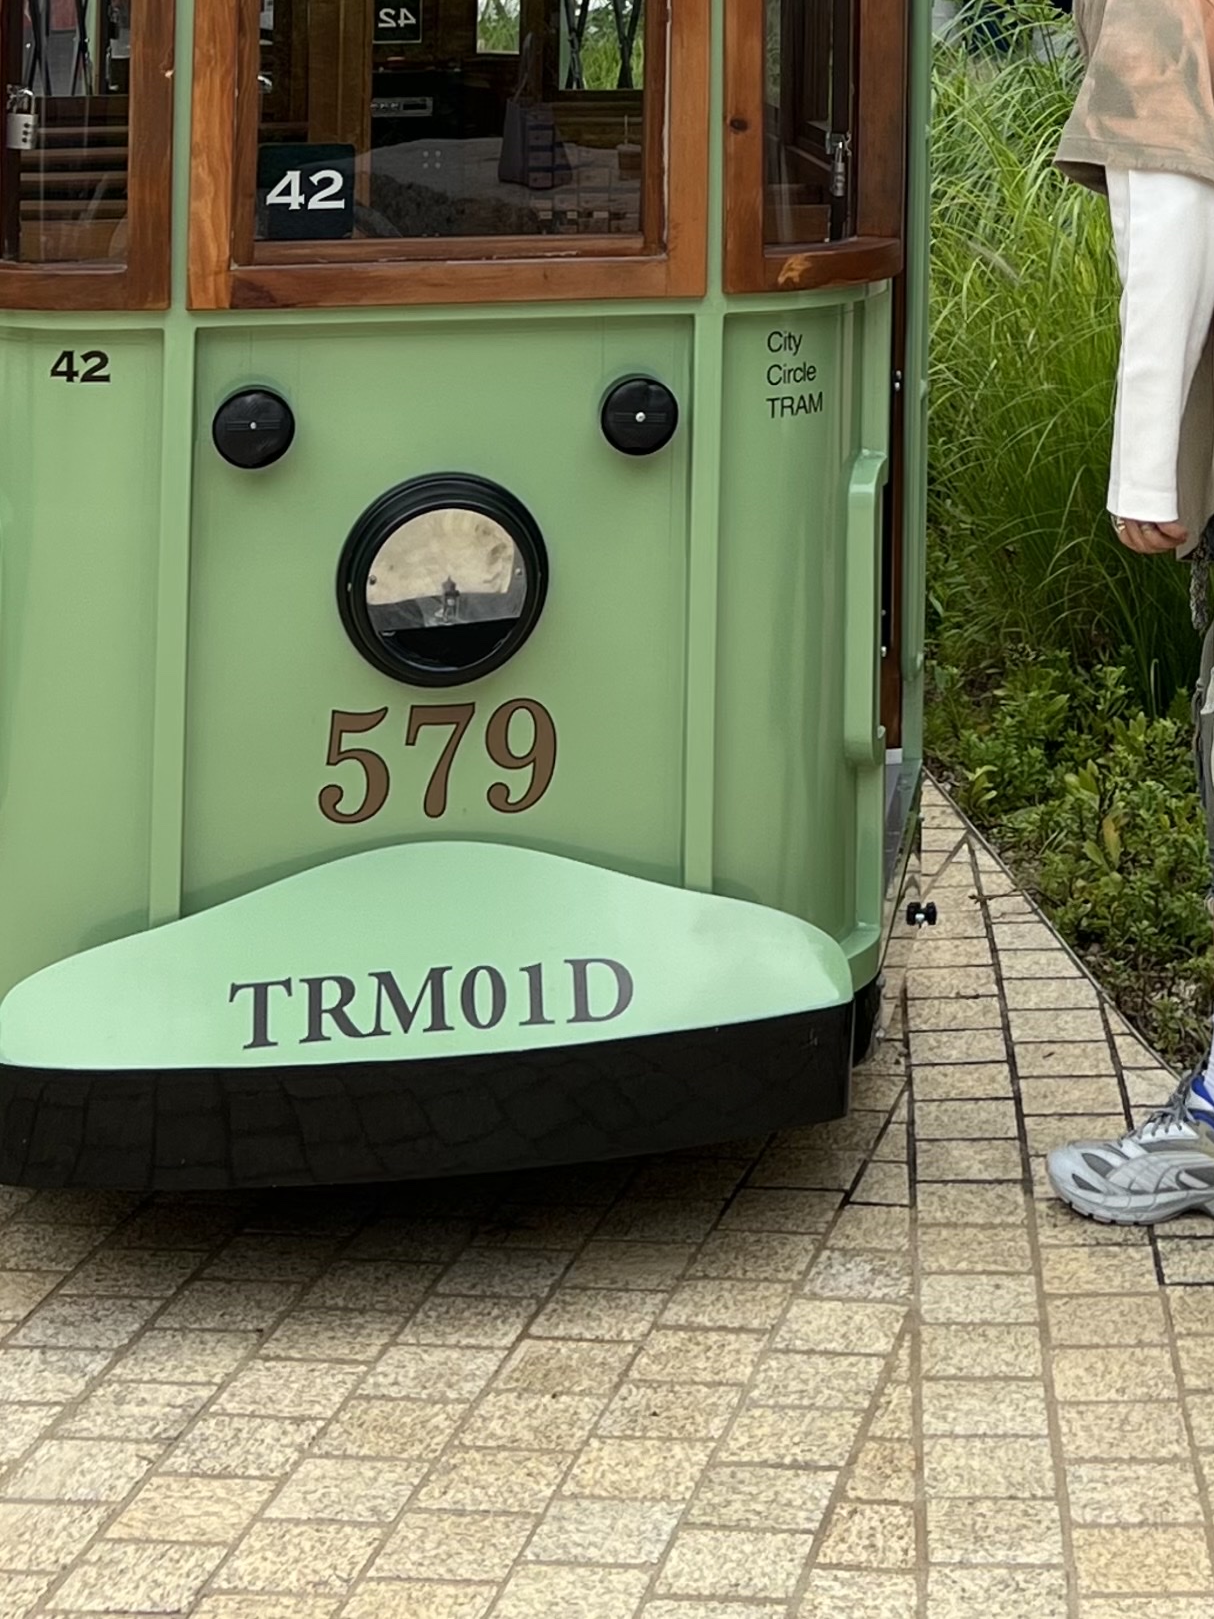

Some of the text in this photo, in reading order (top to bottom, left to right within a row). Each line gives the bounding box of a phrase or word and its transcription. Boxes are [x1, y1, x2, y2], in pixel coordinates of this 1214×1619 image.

[265, 169, 345, 210] 42
[767, 330, 803, 357] City
[50, 350, 111, 383] 42
[766, 361, 817, 386] Circle
[765, 390, 823, 419] TRAM
[317, 697, 558, 825] 579
[228, 958, 635, 1051] TRM01D
